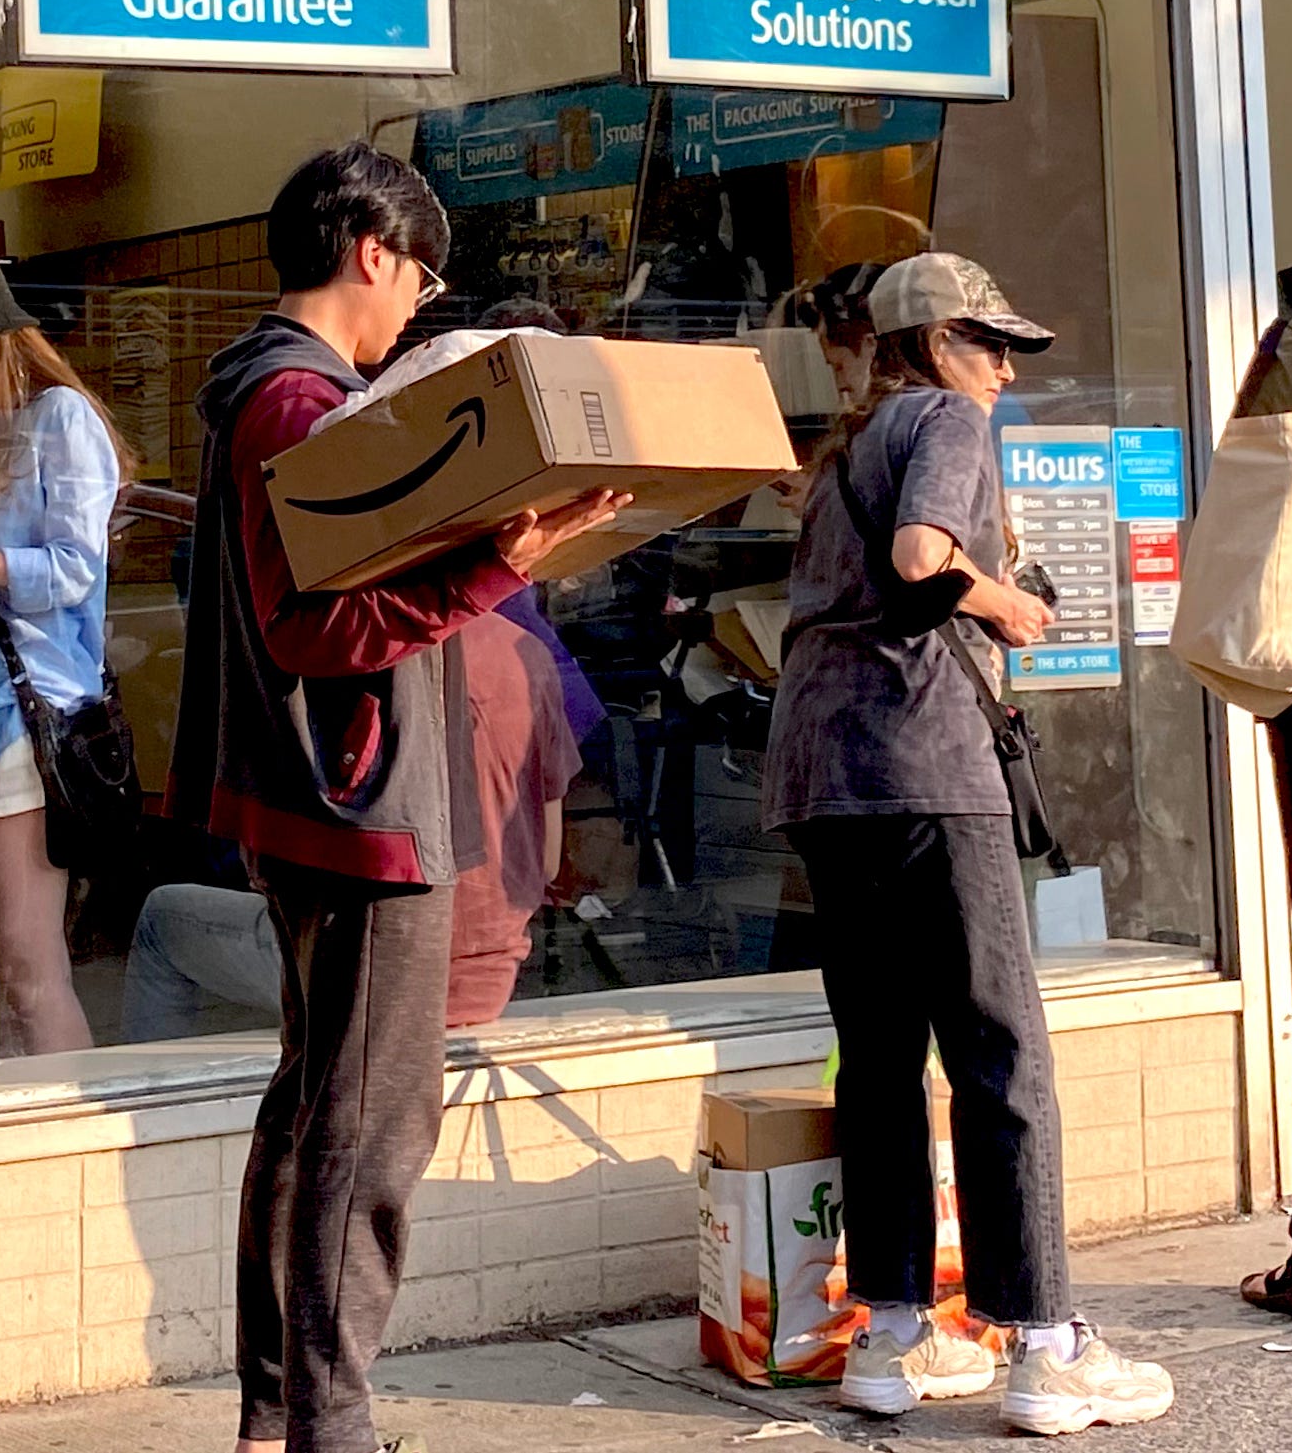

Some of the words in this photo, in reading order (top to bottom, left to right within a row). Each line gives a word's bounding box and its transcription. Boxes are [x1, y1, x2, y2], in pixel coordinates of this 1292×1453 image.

[750, 0, 913, 53] Solutions
[685, 112, 710, 133] THE
[723, 99, 803, 127] PACKAGING
[17, 147, 54, 172] STORE
[465, 143, 517, 168] SUPPLIES
[604, 122, 646, 148] STORE
[1117, 435, 1142, 449] THE
[1012, 448, 1106, 483] Hours
[1140, 482, 1179, 497] STORE
[1036, 657, 1056, 669] THE
[1057, 656, 1078, 669] UPS
[1079, 655, 1111, 668] STORE
